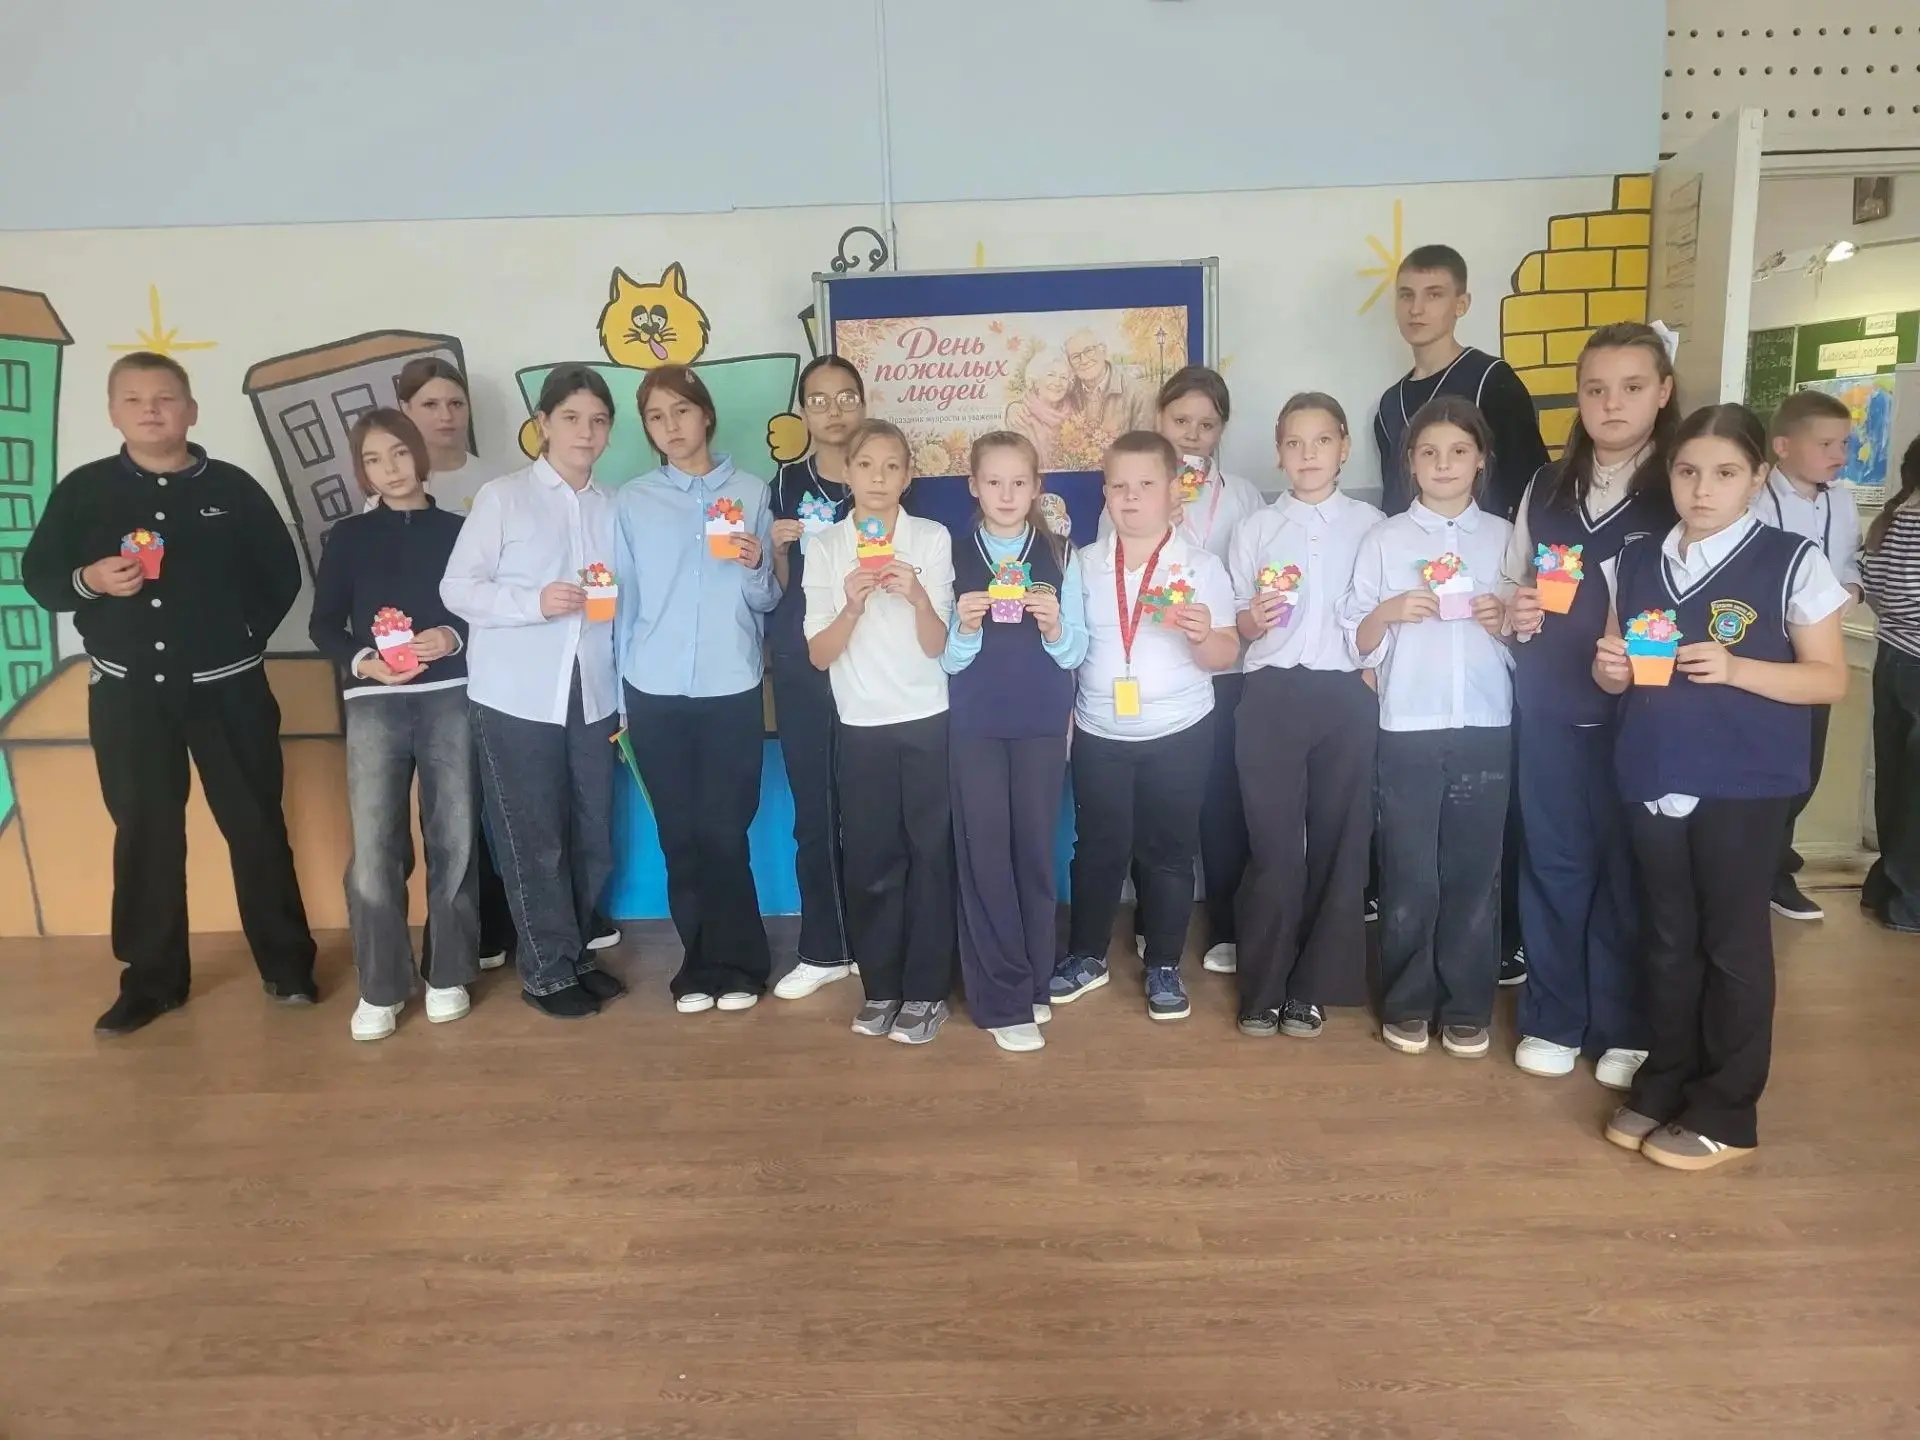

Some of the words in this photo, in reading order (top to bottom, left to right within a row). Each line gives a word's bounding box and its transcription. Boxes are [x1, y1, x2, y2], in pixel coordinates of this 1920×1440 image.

[897, 326, 985, 360] День
[874, 359, 1009, 382] пожилых
[897, 378, 989, 411] людей
